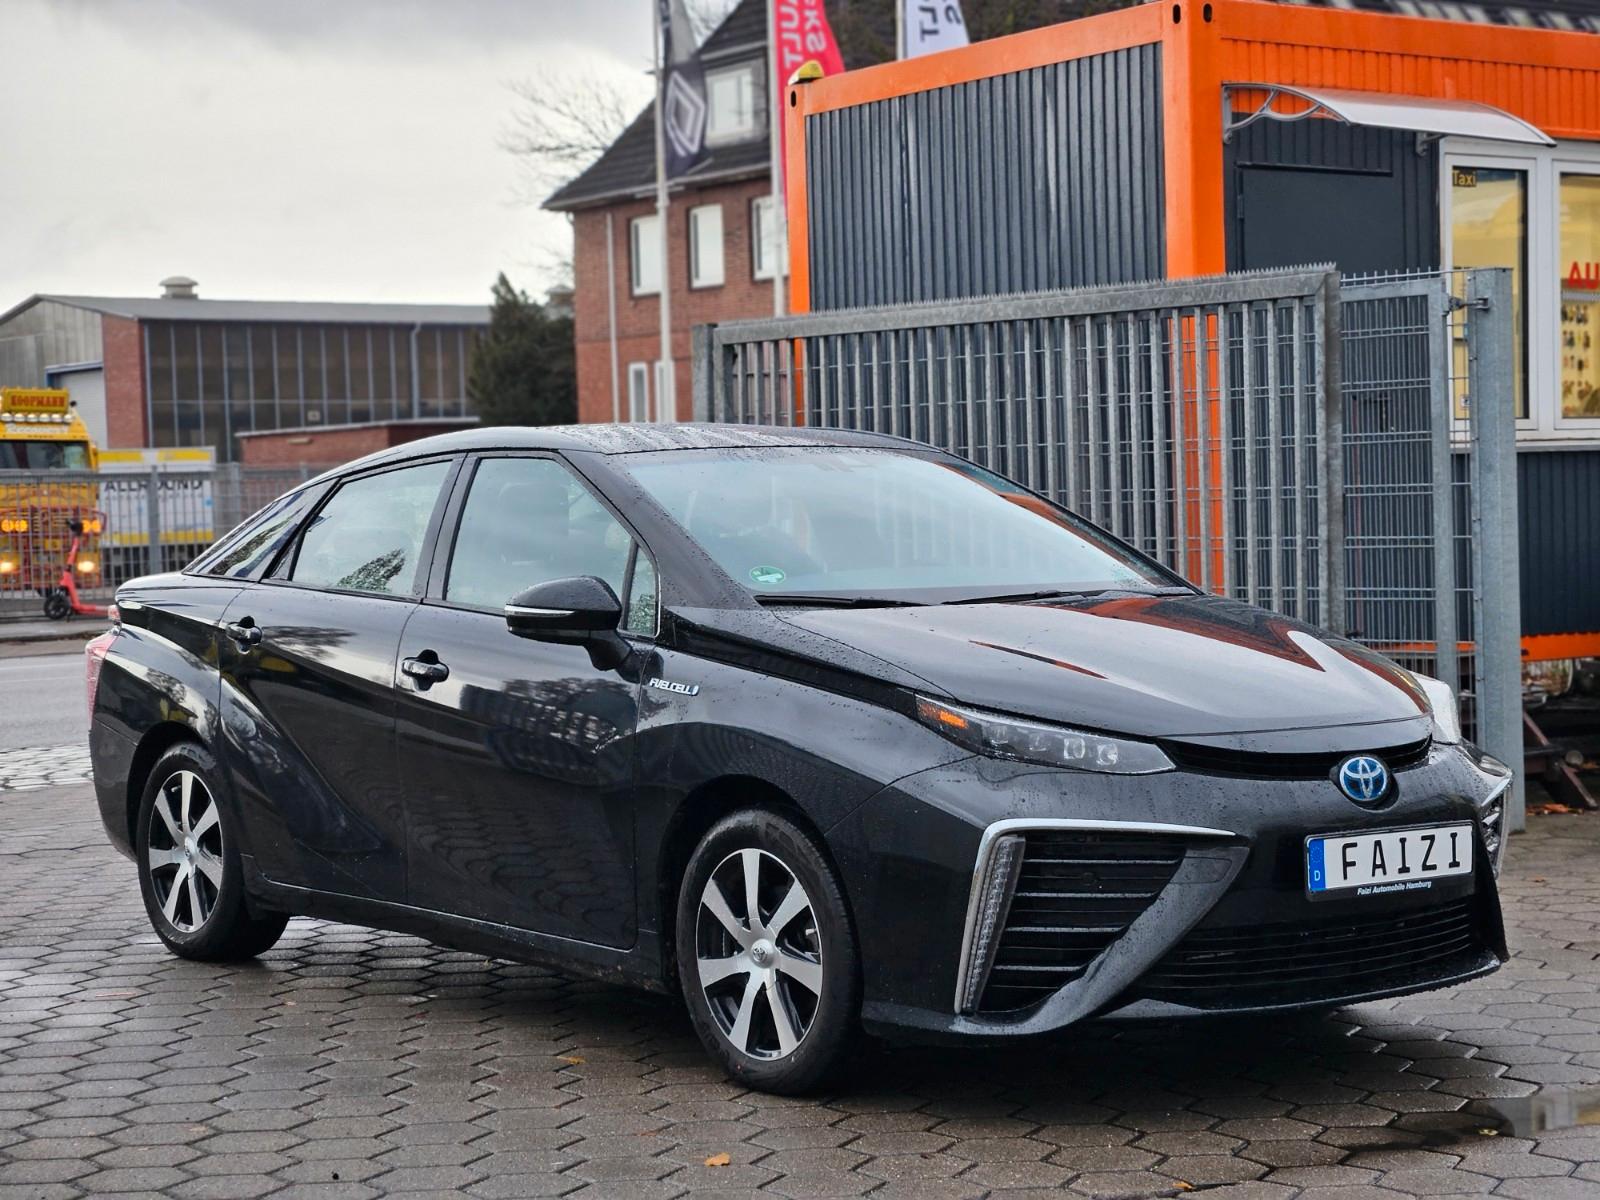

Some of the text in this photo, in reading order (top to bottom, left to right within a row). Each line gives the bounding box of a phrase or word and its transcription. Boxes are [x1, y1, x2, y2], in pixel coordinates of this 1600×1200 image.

[1453, 170, 1476, 185] Taxi
[1314, 832, 1461, 882] D FAIZI
[1357, 880, 1432, 896] Faizi Automobile Hamburg
